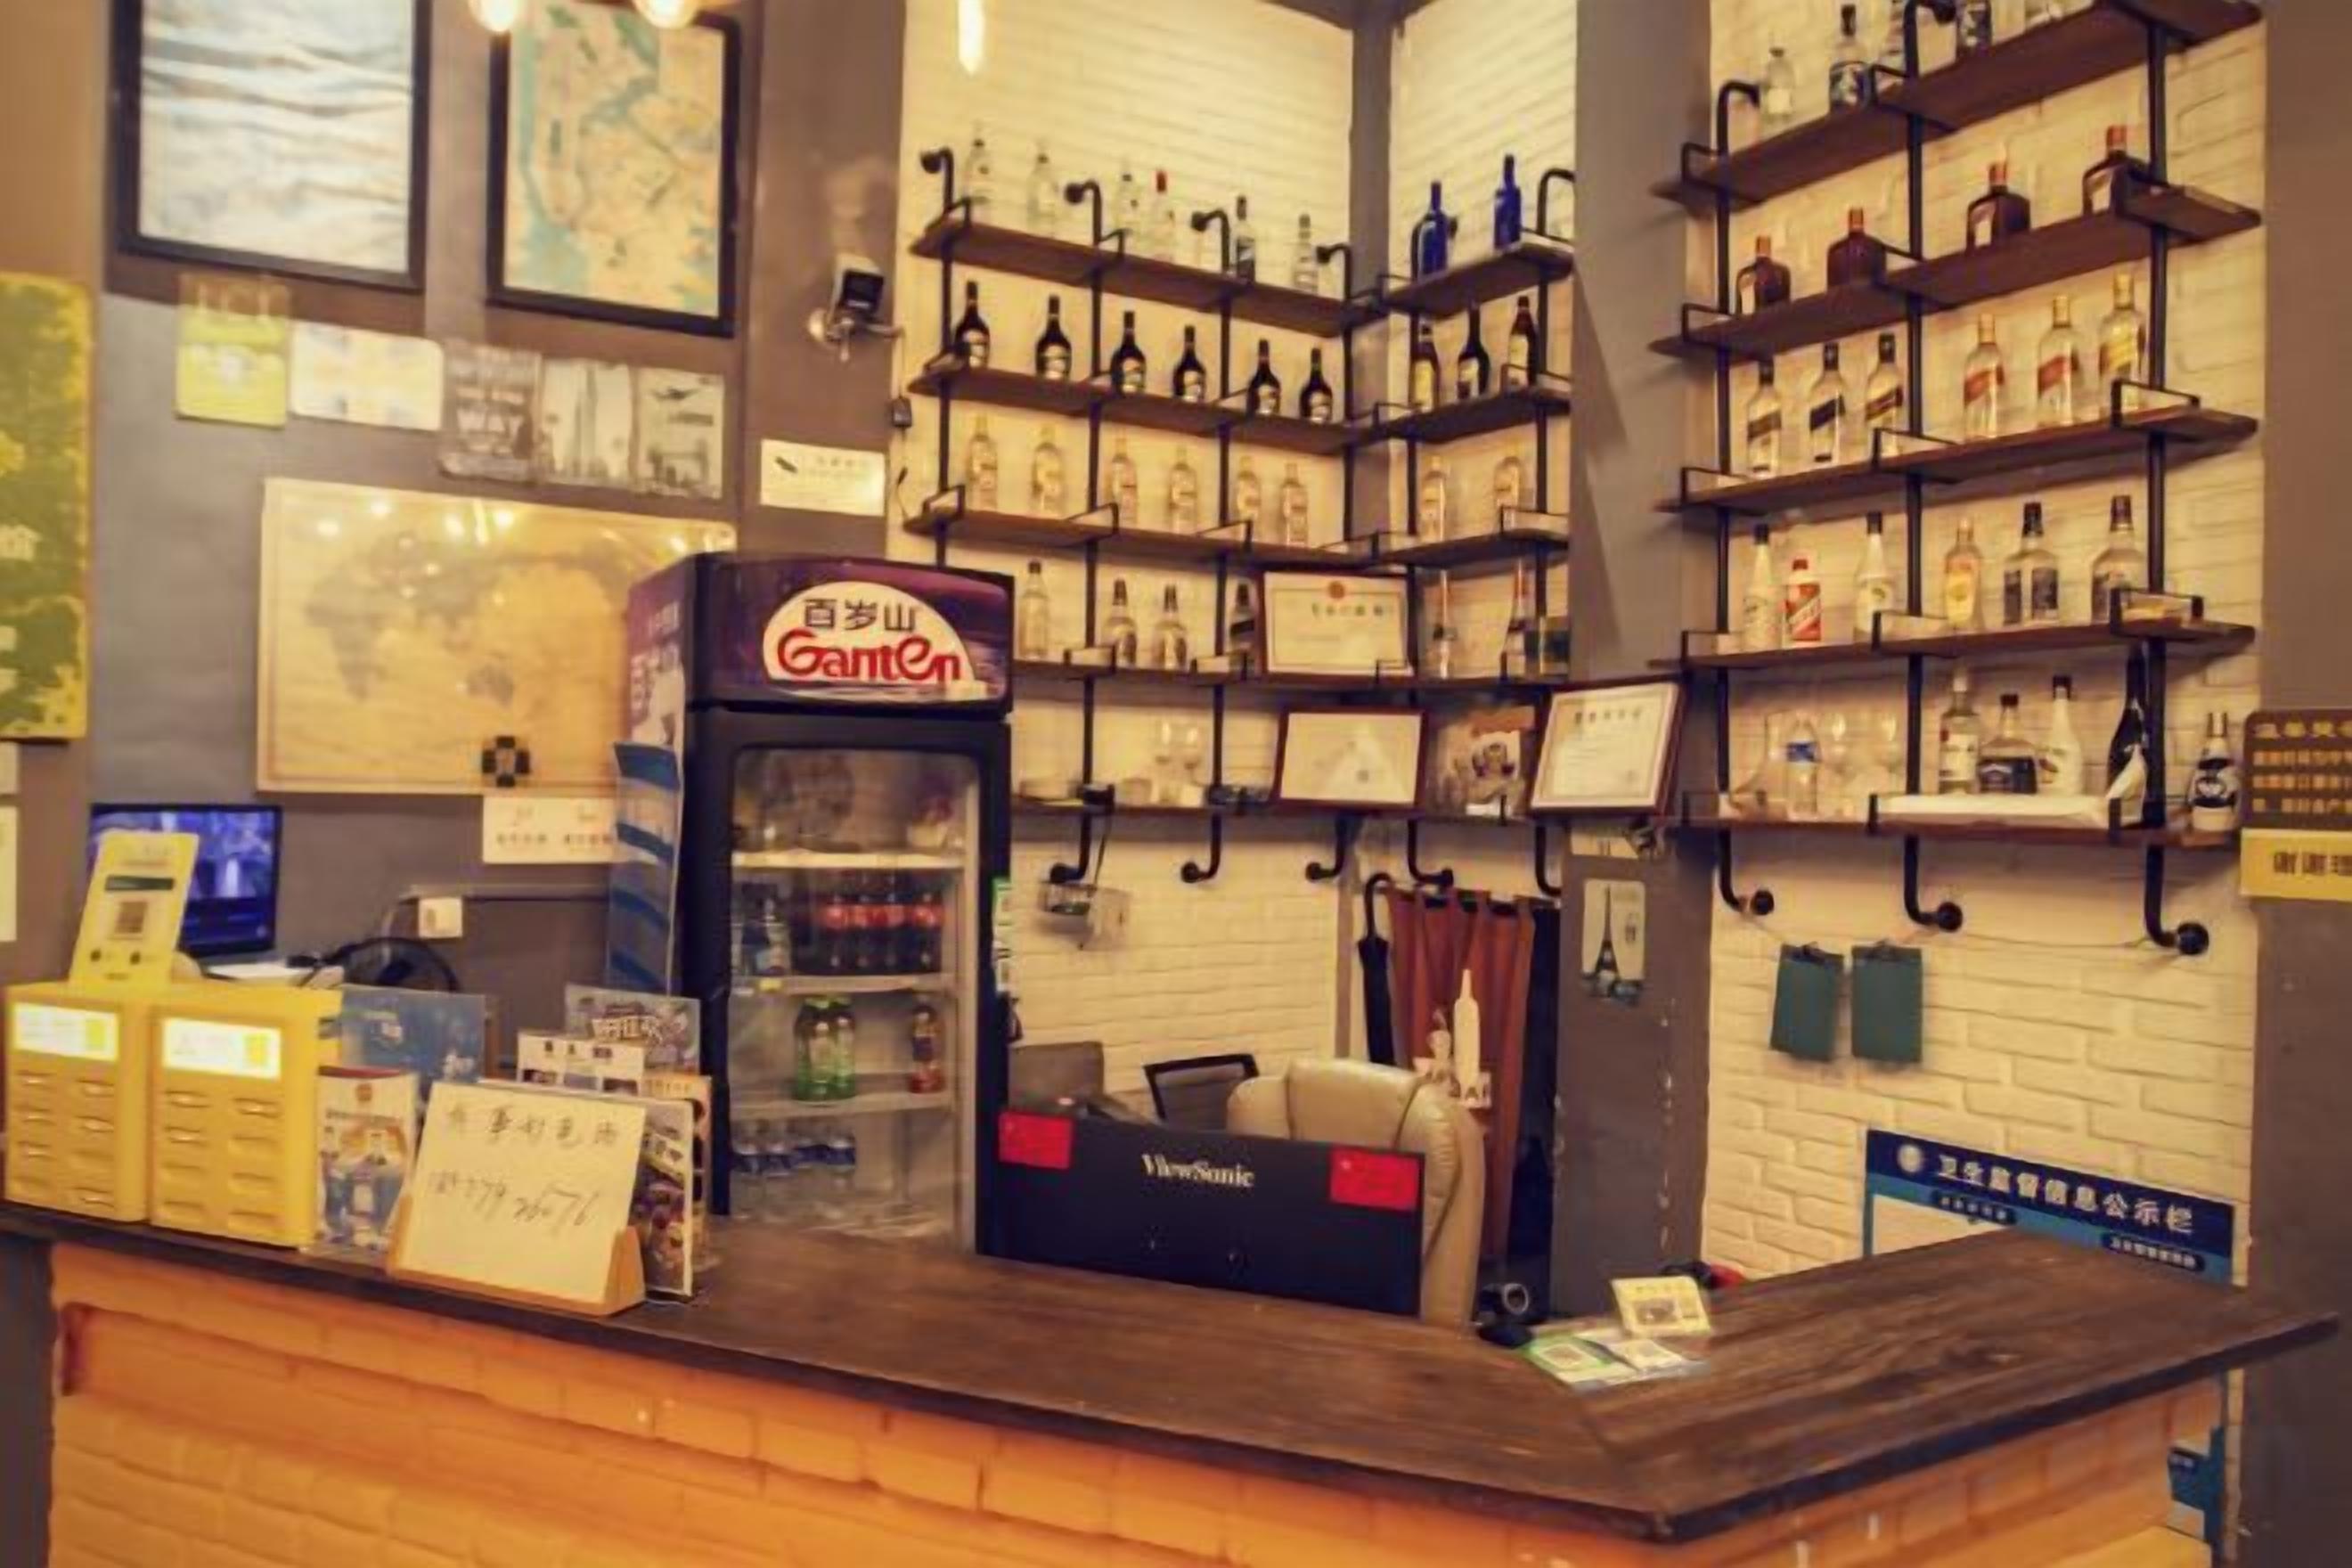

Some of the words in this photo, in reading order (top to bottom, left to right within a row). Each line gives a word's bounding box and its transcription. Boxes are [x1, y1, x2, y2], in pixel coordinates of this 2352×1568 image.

[804, 598, 917, 632] 百岁山
[777, 627, 960, 682] Ganten
[1140, 1153, 1255, 1187] ViewSonic
[1938, 1154, 2193, 1235] 卫生监督信息公示栏
